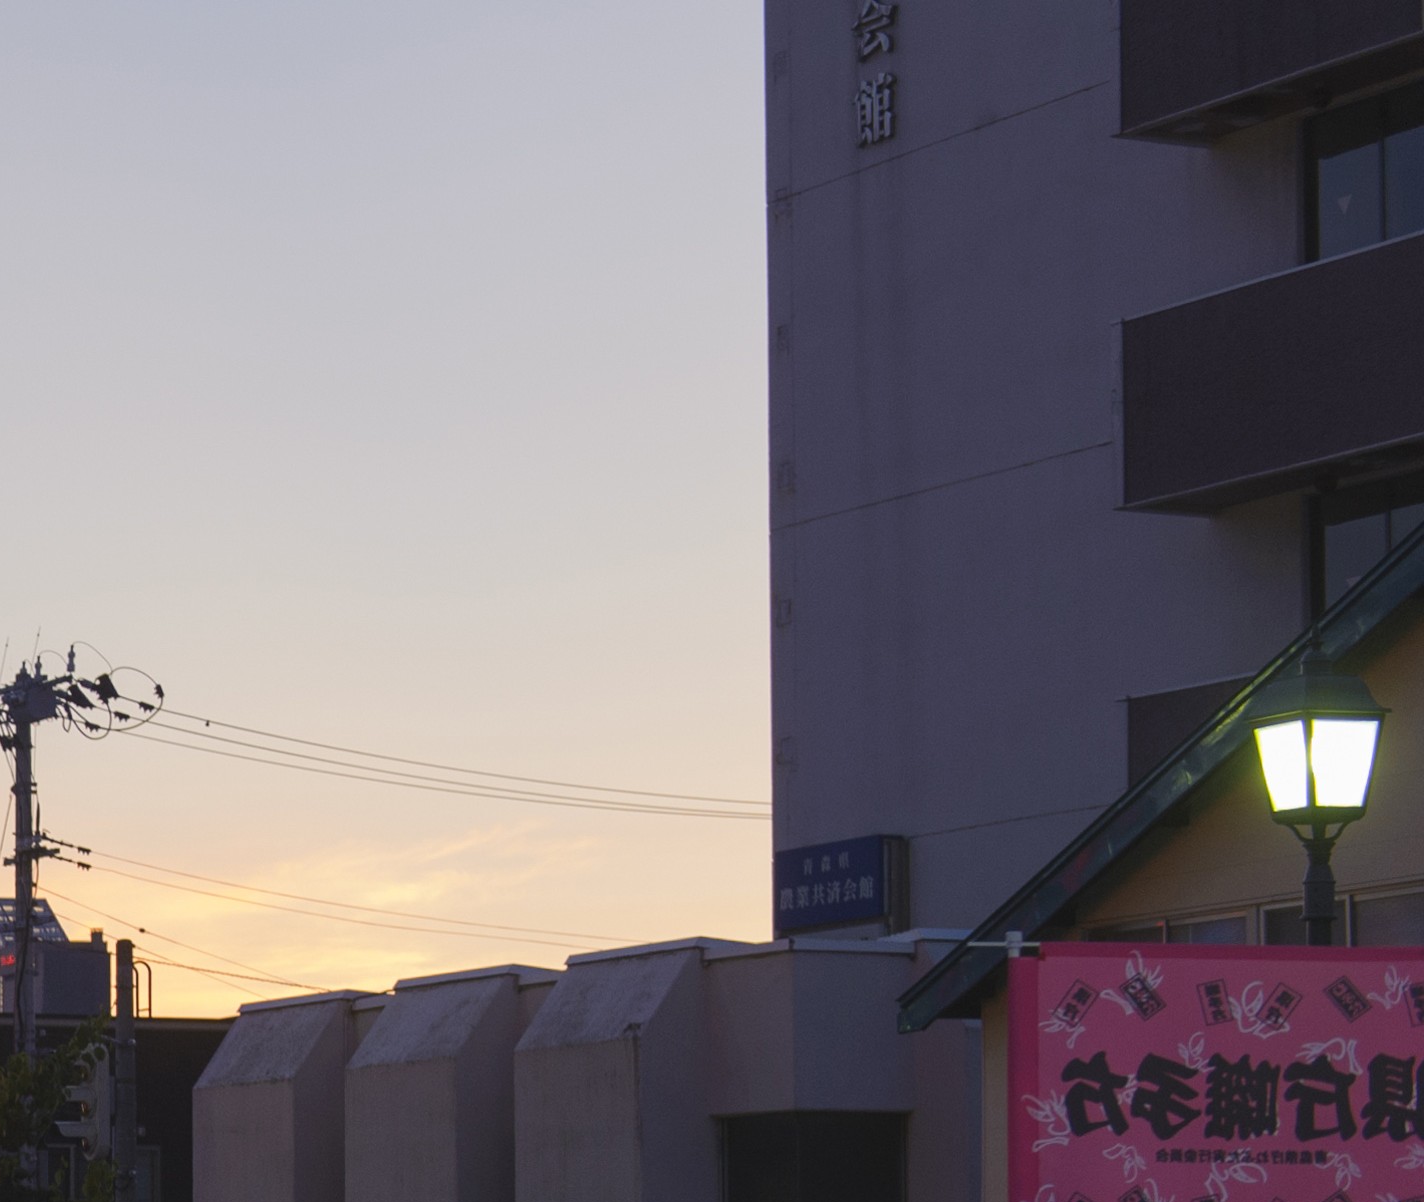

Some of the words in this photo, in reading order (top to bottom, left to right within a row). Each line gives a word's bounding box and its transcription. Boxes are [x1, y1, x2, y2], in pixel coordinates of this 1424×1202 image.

[803, 851, 850, 876] 青森県
[779, 875, 874, 911] 農業共済会館
